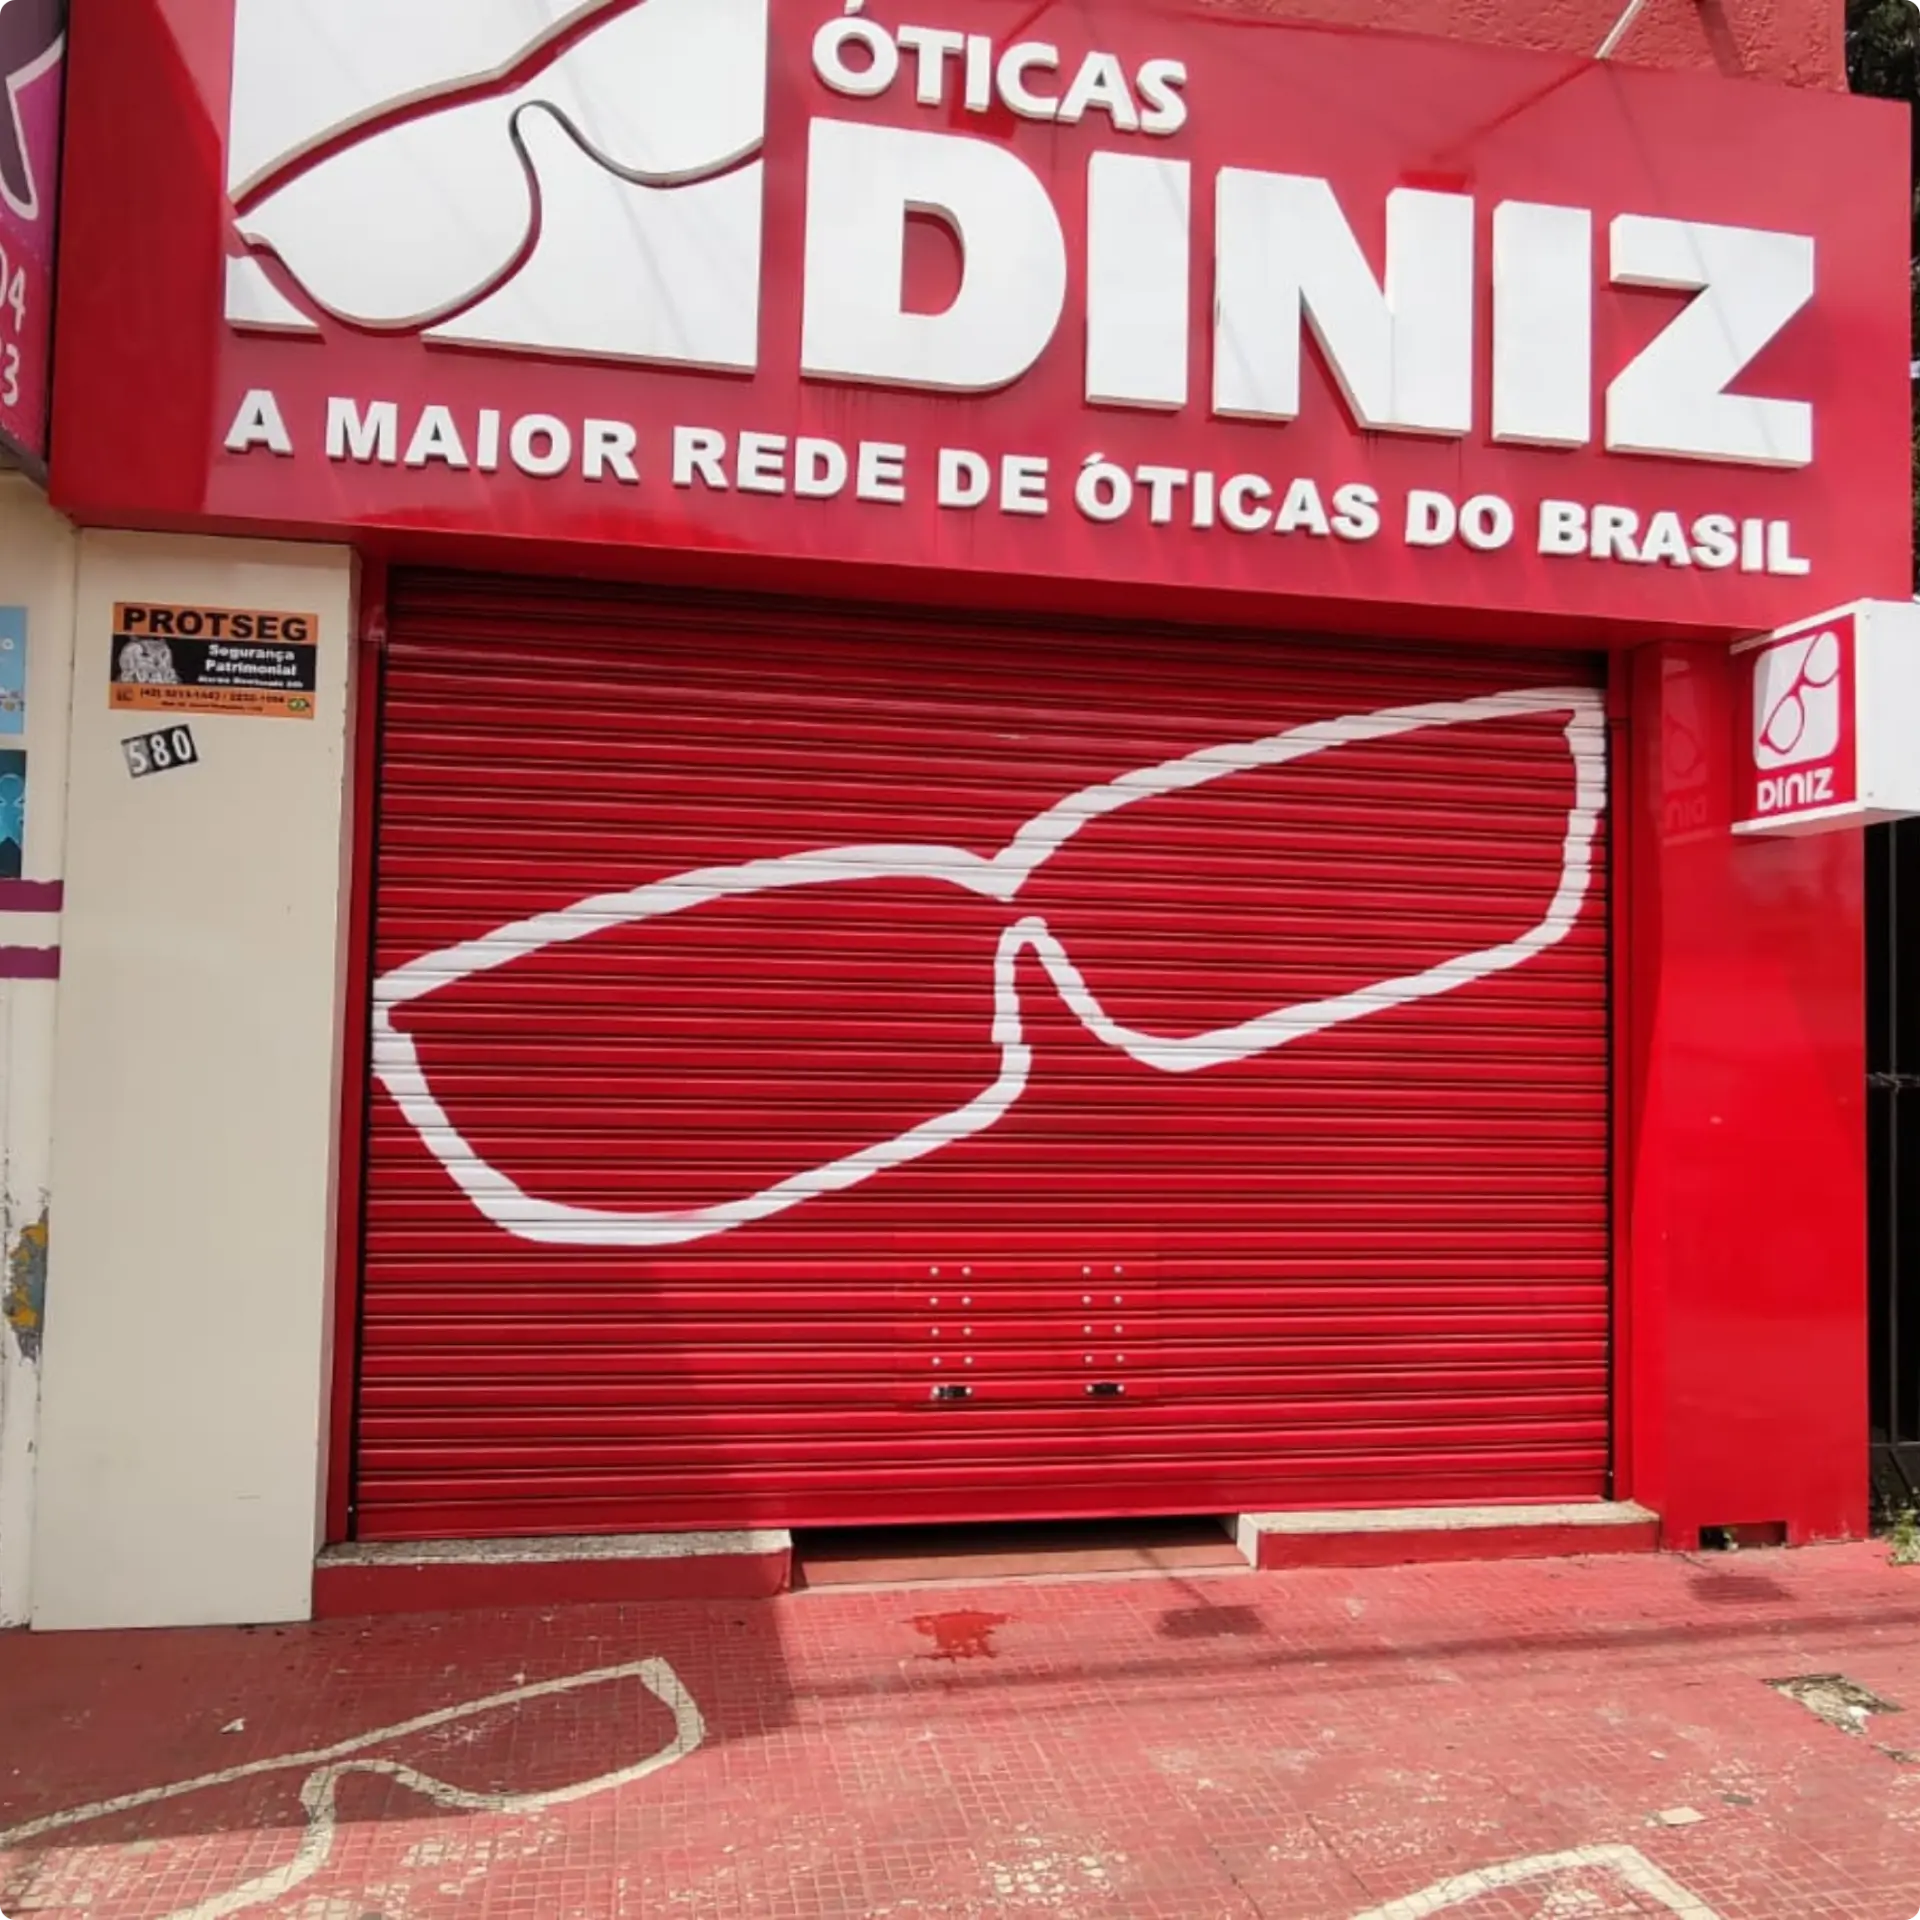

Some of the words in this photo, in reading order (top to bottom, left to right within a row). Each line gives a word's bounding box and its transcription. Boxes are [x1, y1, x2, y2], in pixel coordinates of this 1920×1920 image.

[812, 0, 1188, 135] ÓTICAS
[800, 116, 1815, 467] DINIZ
[224, 389, 294, 456] A
[325, 396, 640, 482] MAIOR
[672, 425, 906, 504] REDE
[937, 448, 1049, 514] DE
[1075, 451, 1380, 541] ÓTICAS
[1404, 489, 1514, 553] DO
[1537, 500, 1811, 576] BRASIL
[123, 607, 308, 641] PROTSEG
[205, 659, 297, 676] Patrimonial
[208, 643, 295, 662] Segurança
[128, 728, 192, 776] 580
[1757, 767, 1833, 812] DINIZ
